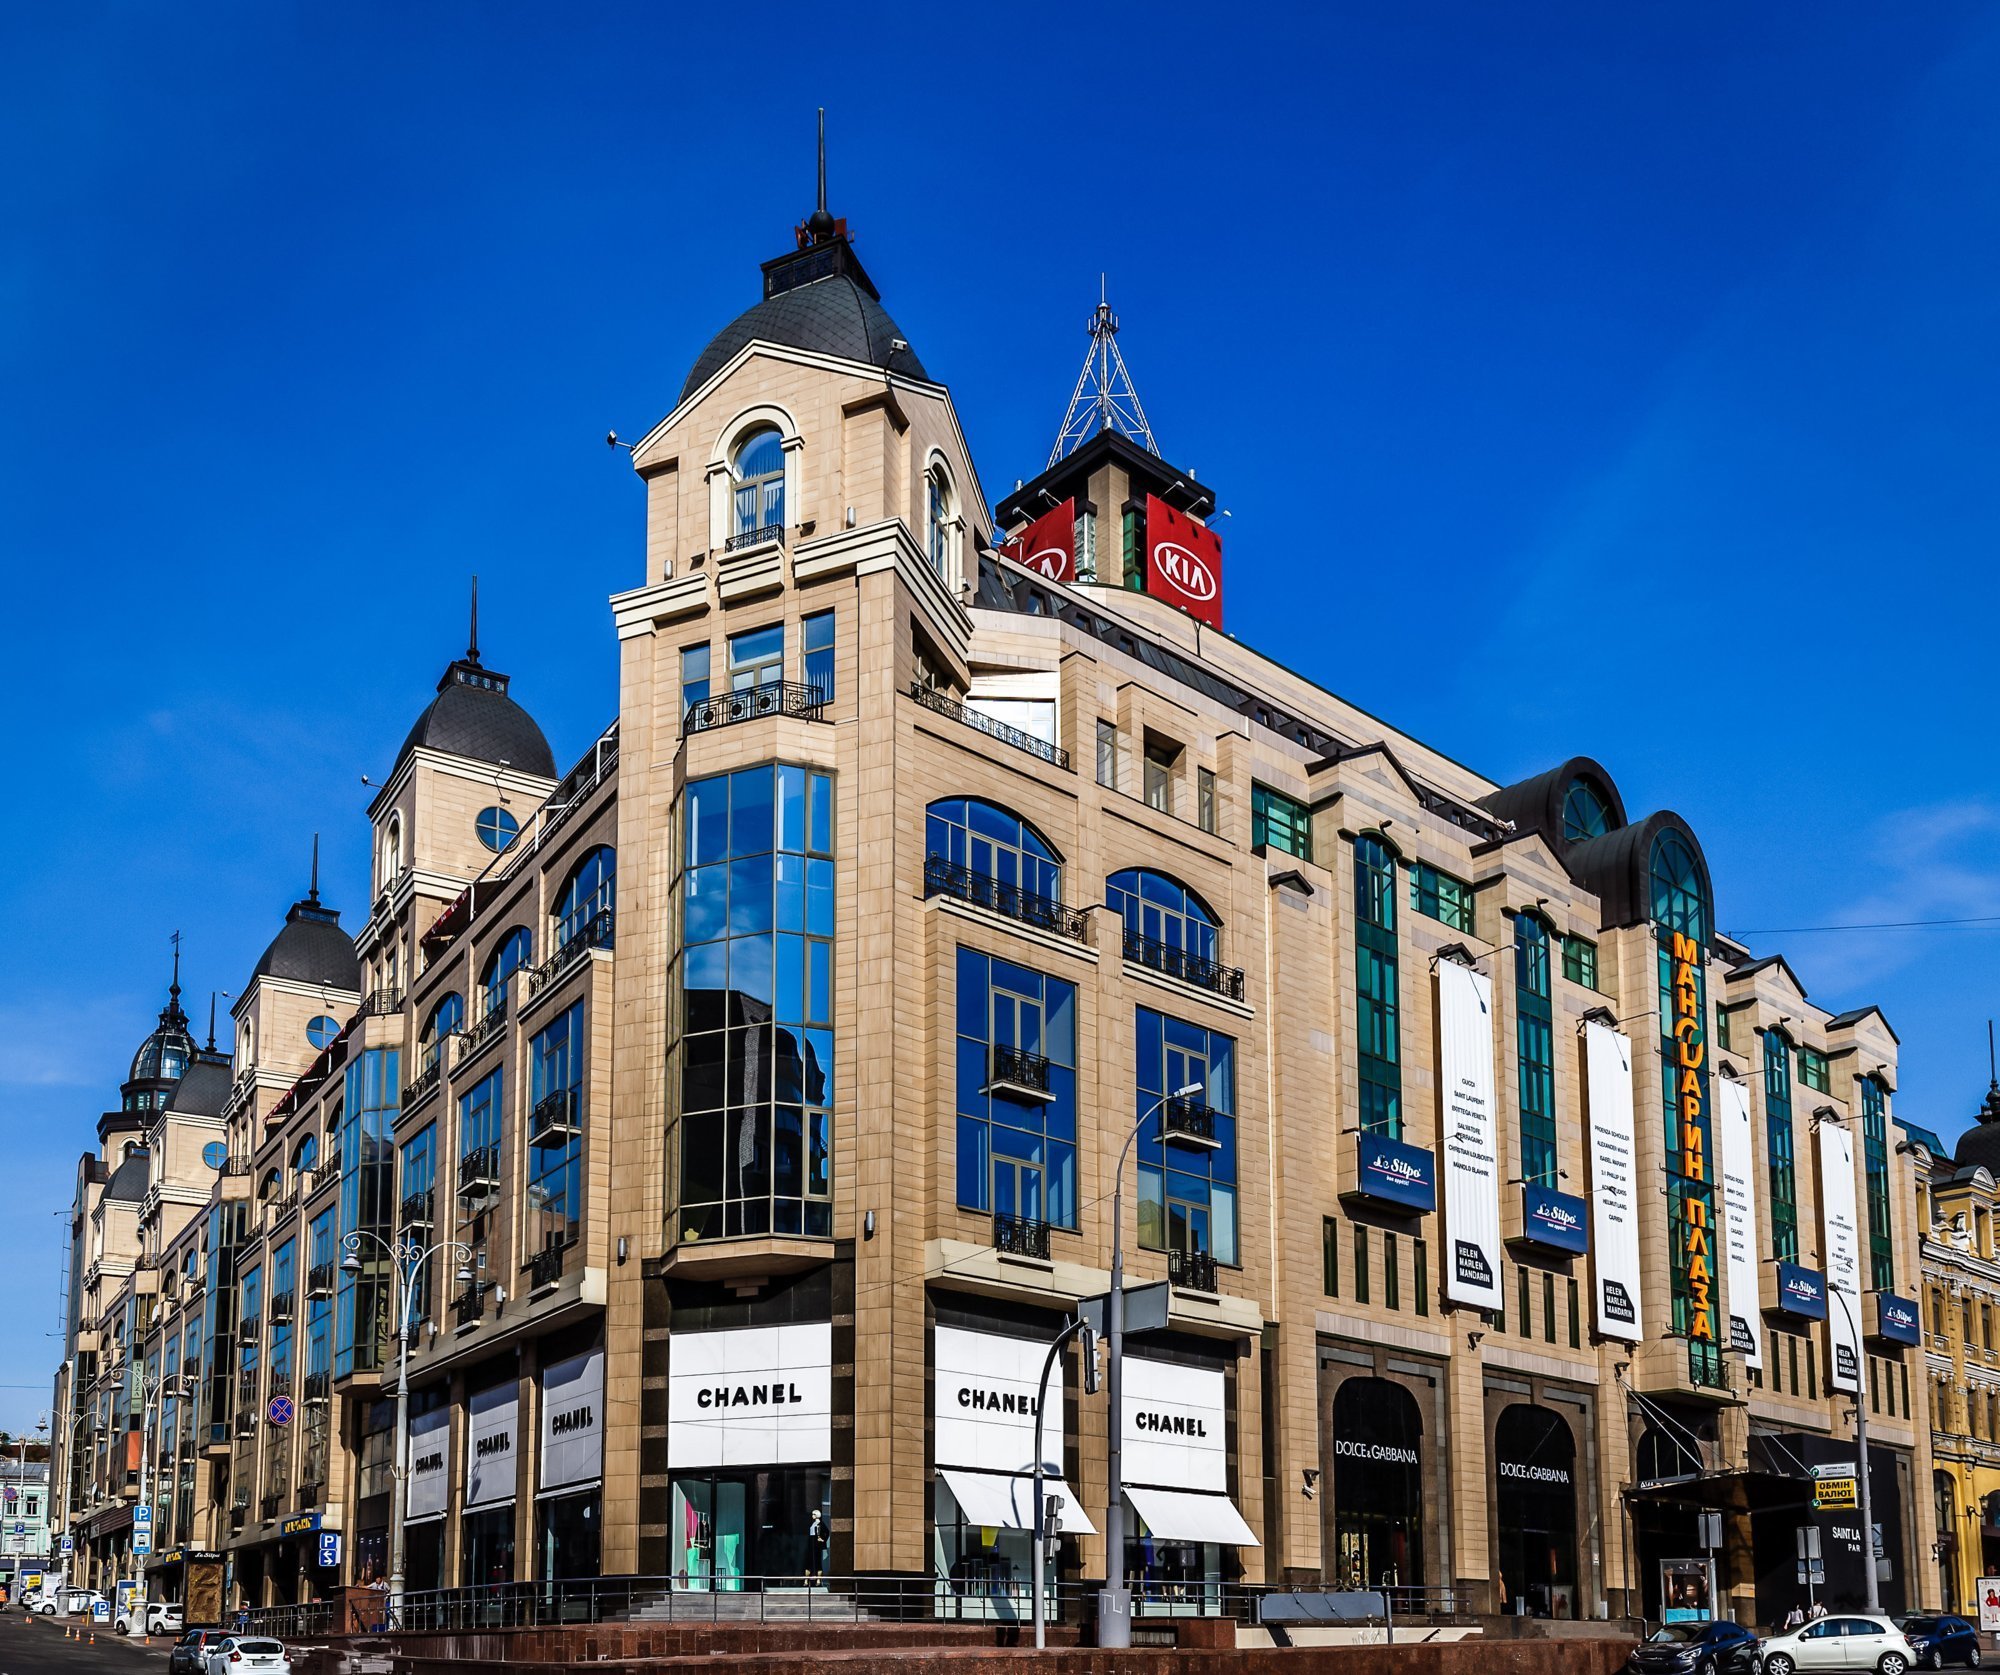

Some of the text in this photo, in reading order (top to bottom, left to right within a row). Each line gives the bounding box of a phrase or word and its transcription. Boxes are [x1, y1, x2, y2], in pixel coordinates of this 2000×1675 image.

[1165, 548, 1206, 594] KIA
[1462, 1078, 1475, 1088] GUCCI
[1452, 1105, 1471, 1117] BOTTEGA
[1457, 1132, 1483, 1145] ERRAGAMO
[1373, 1154, 1421, 1180] Le Silpo
[1453, 1161, 1472, 1173] MANOLO
[1536, 1203, 1577, 1226] Le Silpo
[1458, 1246, 1478, 1259] HELEN
[1459, 1257, 1483, 1271] MARLEN
[1687, 1197, 1712, 1340] ПЛАЗА
[1459, 1267, 1490, 1283] MANDARIN
[1605, 1285, 1623, 1297] HELEN
[1606, 1295, 1627, 1307] MARLEN
[1606, 1304, 1633, 1318] MANDARIN
[1731, 1320, 1745, 1330] HELEN
[1731, 1329, 1749, 1340] MARLEN
[1731, 1338, 1754, 1350] MANDARIN
[1838, 1348, 1851, 1358] HELEN
[1838, 1357, 1854, 1367] MARLEN
[697, 1383, 802, 1408] CHANEL
[958, 1387, 1039, 1416] CHANEL
[552, 1406, 593, 1436] CHANEL
[1135, 1412, 1207, 1437] CHANEL
[476, 1431, 510, 1458] CHANEL
[415, 1452, 443, 1475] CHANEL
[1819, 1481, 1850, 1490] ОБМІН
[1818, 1490, 1852, 1498] ВАЛЮТ
[139, 1508, 148, 1520] P
[1832, 1526, 1851, 1540] SAINT
[324, 1536, 334, 1547] P
